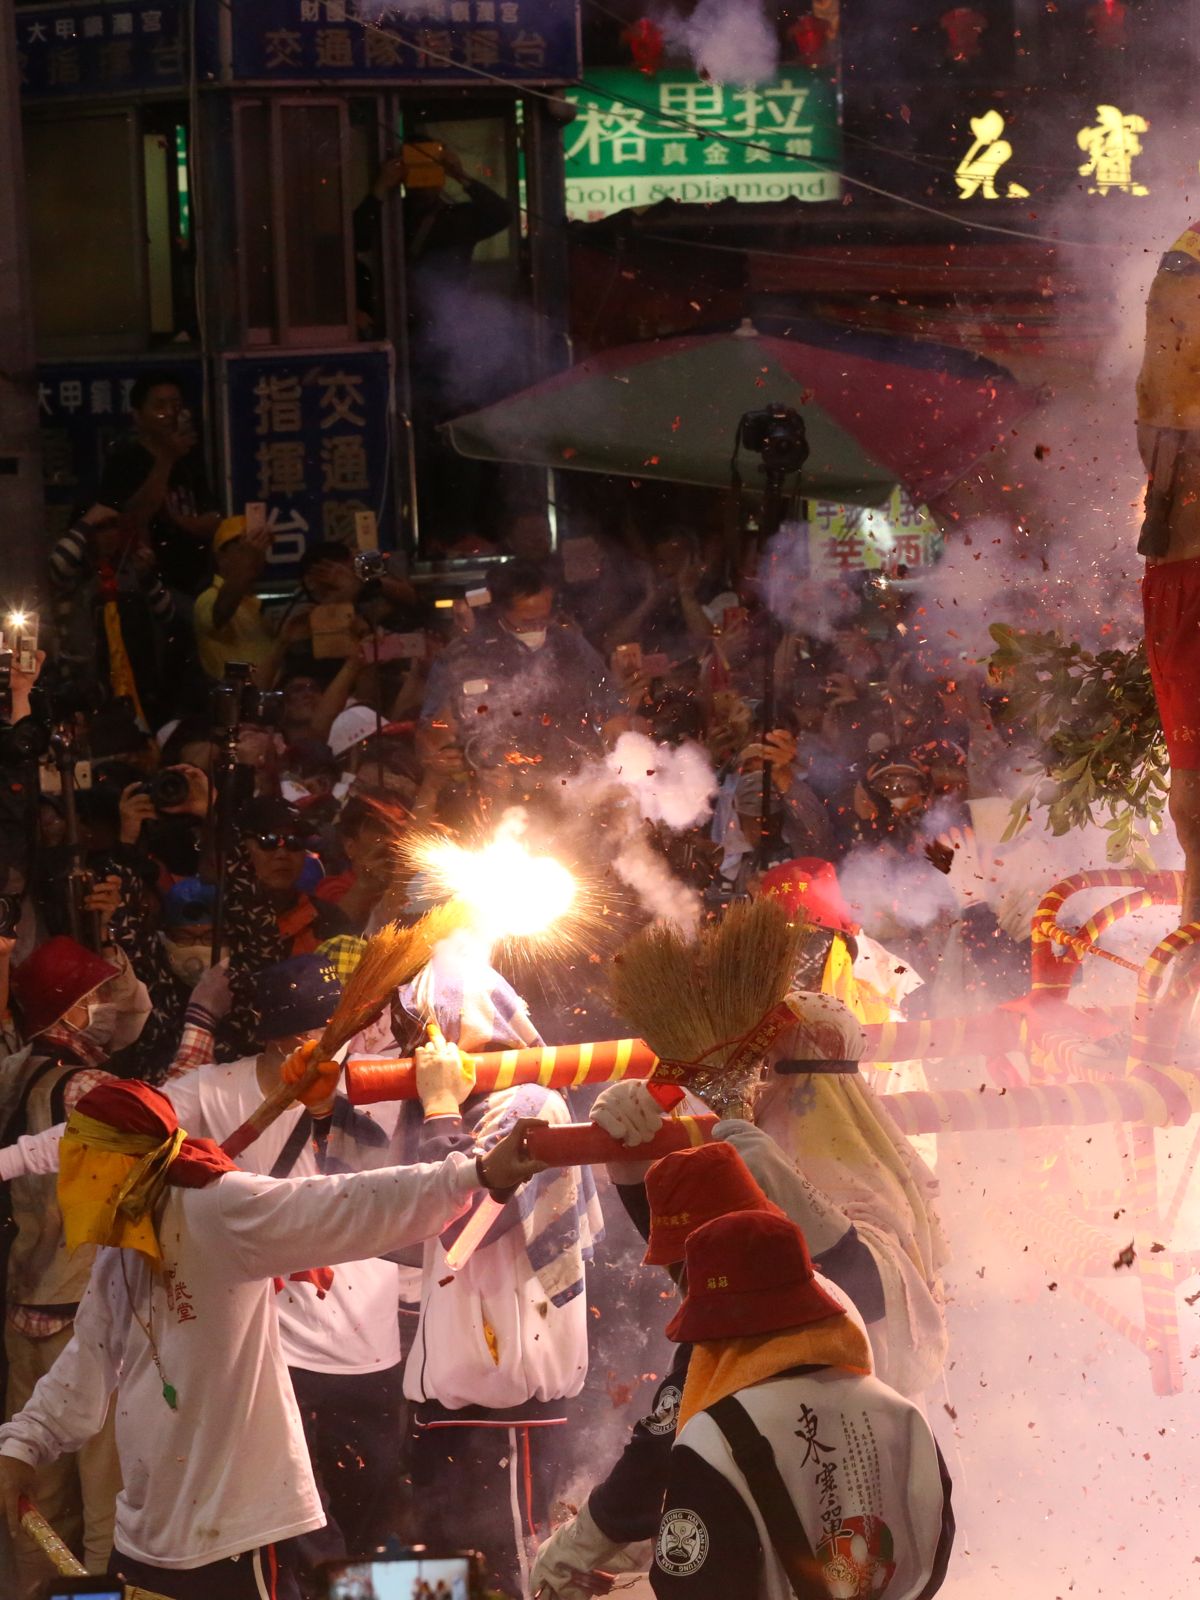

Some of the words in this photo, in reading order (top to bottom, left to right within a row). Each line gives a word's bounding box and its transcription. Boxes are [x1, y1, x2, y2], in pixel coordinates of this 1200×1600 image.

[265, 27, 547, 69] 交通隊指揮台
[565, 80, 813, 166] 格里拉
[254, 375, 309, 564] 指揮台
